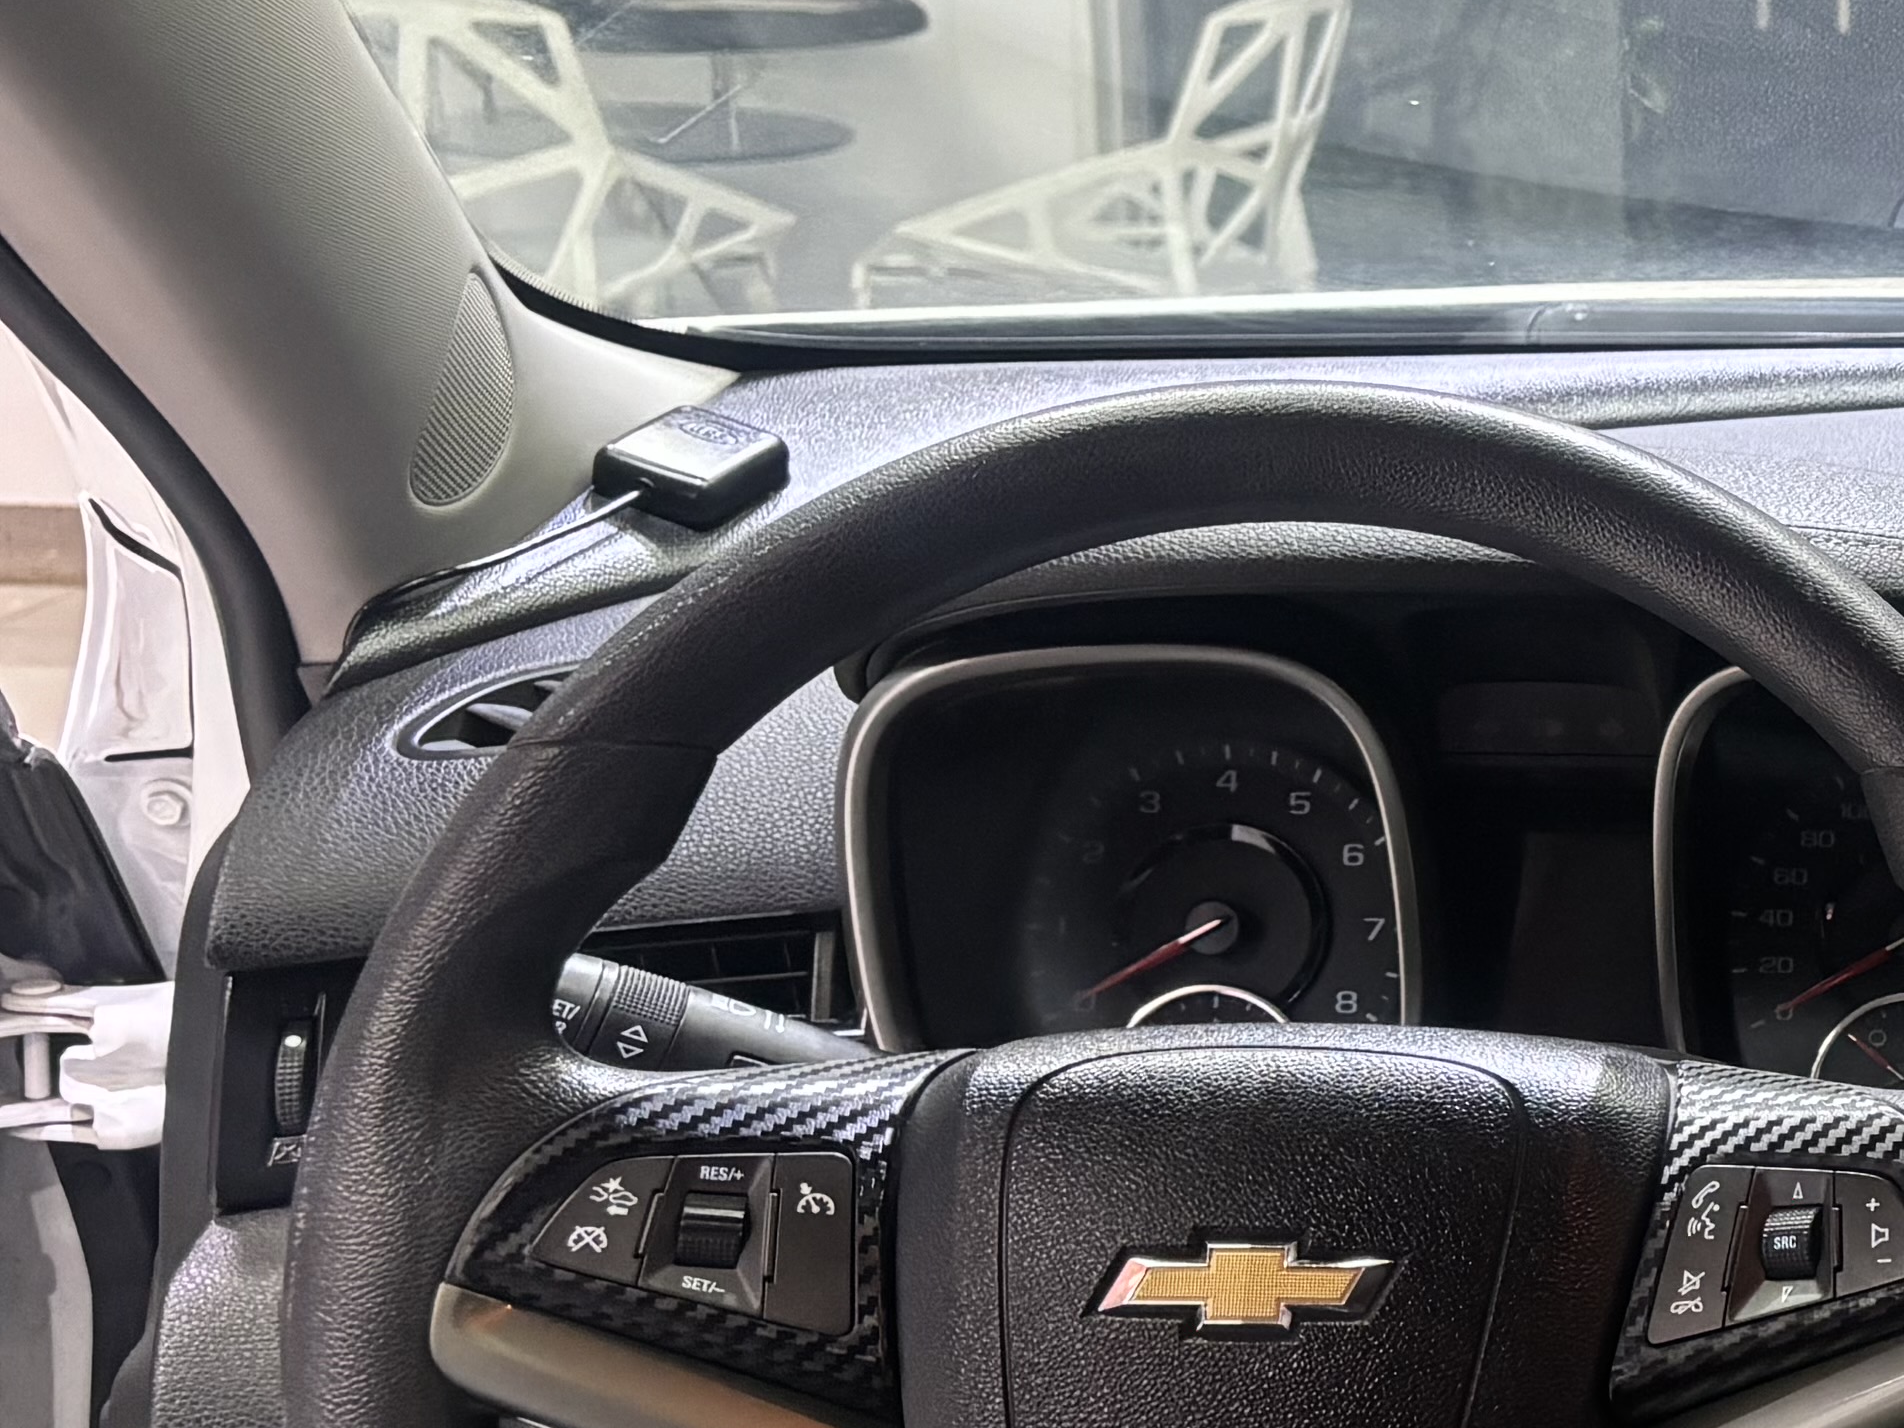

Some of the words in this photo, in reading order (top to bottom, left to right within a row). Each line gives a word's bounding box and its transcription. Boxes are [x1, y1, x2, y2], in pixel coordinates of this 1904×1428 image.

[1216, 770, 1239, 792] 4
[1138, 791, 1162, 813] 3
[1289, 792, 1311, 815] 5
[1801, 830, 1835, 849] 80
[1342, 843, 1365, 866] 6
[1773, 868, 1808, 887] 60
[1759, 908, 1793, 927] 40
[1363, 917, 1386, 942] 7
[1759, 956, 1794, 975] 20
[1335, 990, 1358, 1014] 8
[1773, 1235, 1798, 1250] SRC
